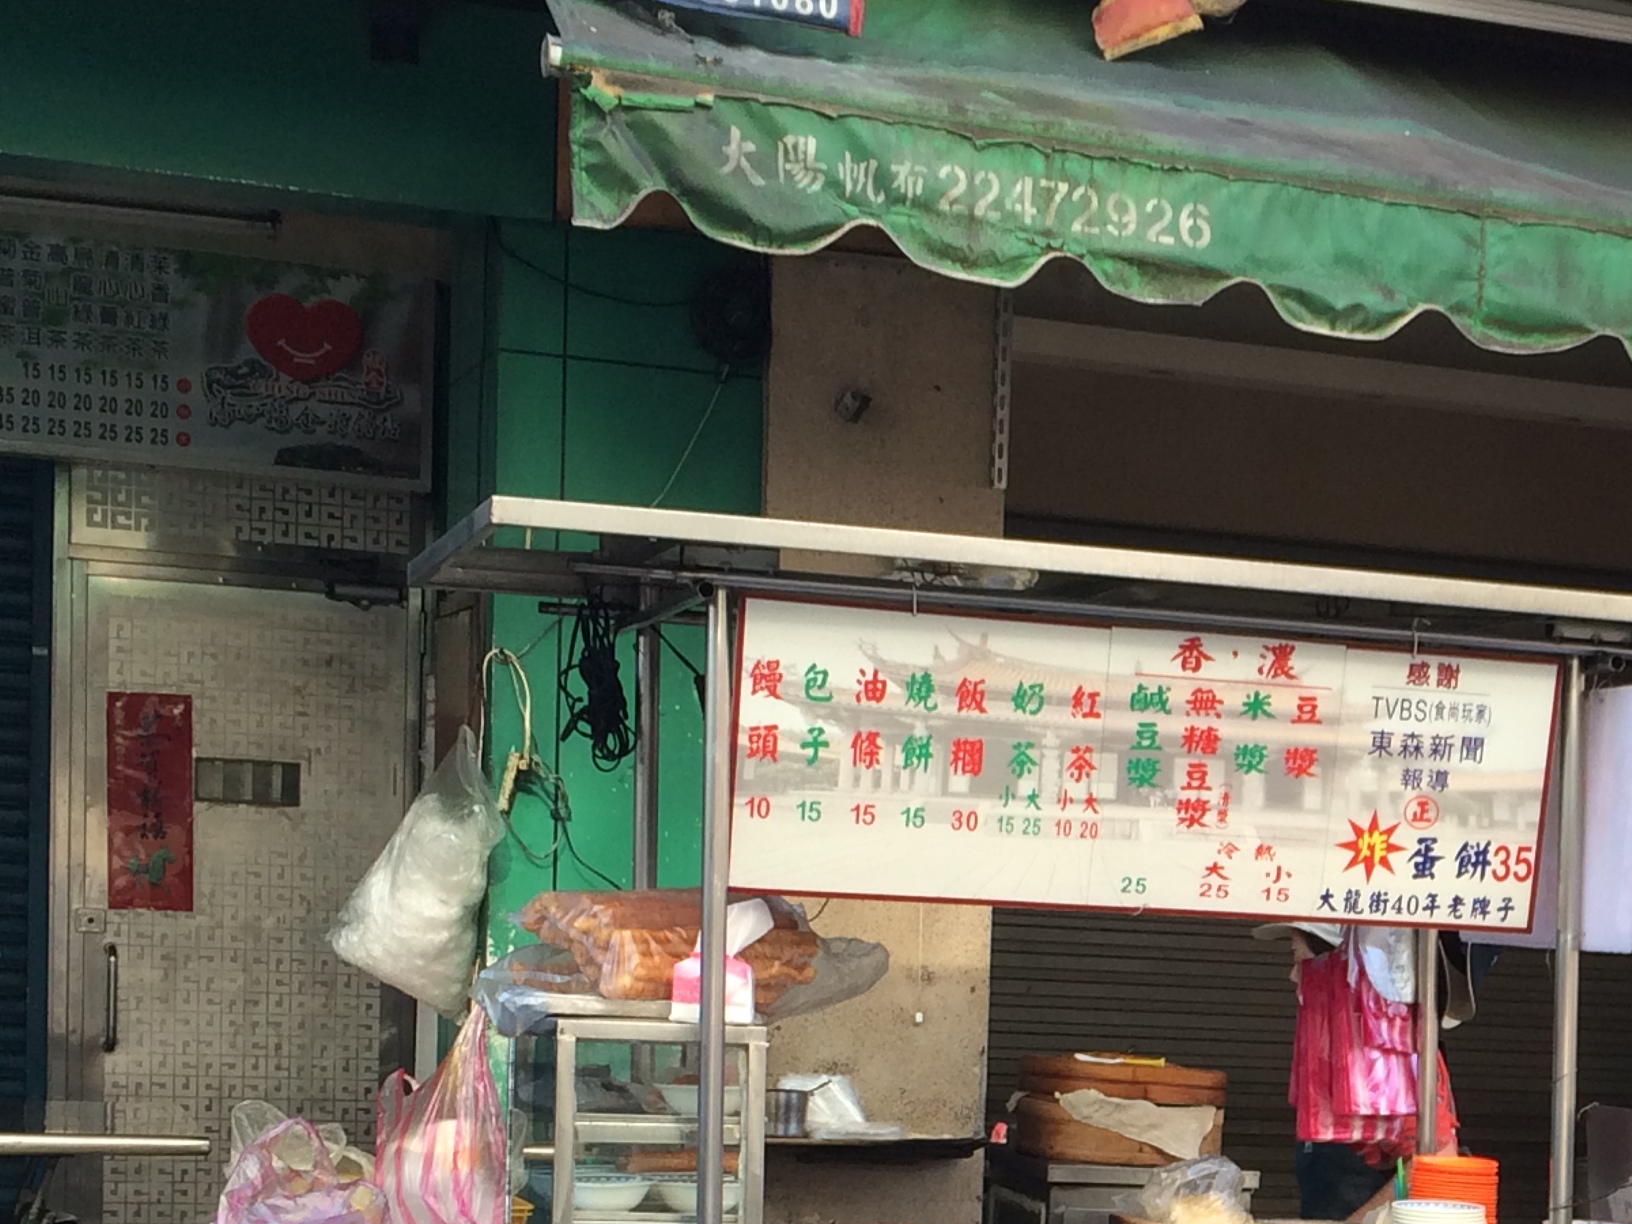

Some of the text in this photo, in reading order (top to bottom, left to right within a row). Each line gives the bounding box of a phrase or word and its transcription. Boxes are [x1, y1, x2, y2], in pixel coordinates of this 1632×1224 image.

[938, 163, 1213, 249] 22472926
[21, 388, 40, 407] 20
[48, 391, 66, 409] 20
[74, 393, 92, 411] 20
[100, 395, 118, 414] 20
[125, 398, 144, 417] 20
[151, 401, 169, 419] 20
[22, 362, 40, 380] 15
[48, 364, 66, 382] 15
[75, 367, 92, 385] 15
[102, 370, 118, 387] 15
[126, 372, 144, 389] 15
[153, 374, 169, 392] 15
[21, 416, 40, 434] 25
[48, 418, 66, 436] 25
[74, 421, 92, 438] 25
[100, 423, 118, 441] 25
[125, 425, 144, 444] 25
[151, 428, 169, 445] 25
[1406, 661, 1460, 690] 感謝
[747, 659, 784, 763] 饅頭
[800, 663, 834, 766] 包子
[850, 668, 888, 769] 油條
[902, 671, 938, 773] 燒餅
[950, 677, 988, 777] 飯糰
[1008, 680, 1046, 779] 奶茶
[1065, 685, 1102, 783] 紅茶
[1233, 690, 1277, 775] 米漿
[1283, 696, 1323, 779] 豆漿
[1176, 687, 1224, 829] 無糖豆漿
[1368, 730, 1485, 764] 東森新聞
[999, 785, 1099, 814] 小 大 小 大
[1400, 768, 1450, 793] 報導
[745, 797, 1099, 839] 10 15 15 15 30 15 25 10 20
[1201, 862, 1293, 884] 大 小
[1217, 842, 1241, 860] 冷
[1356, 830, 1533, 883] 炸 蛋餅 35
[1121, 877, 1291, 903] 25 25 15
